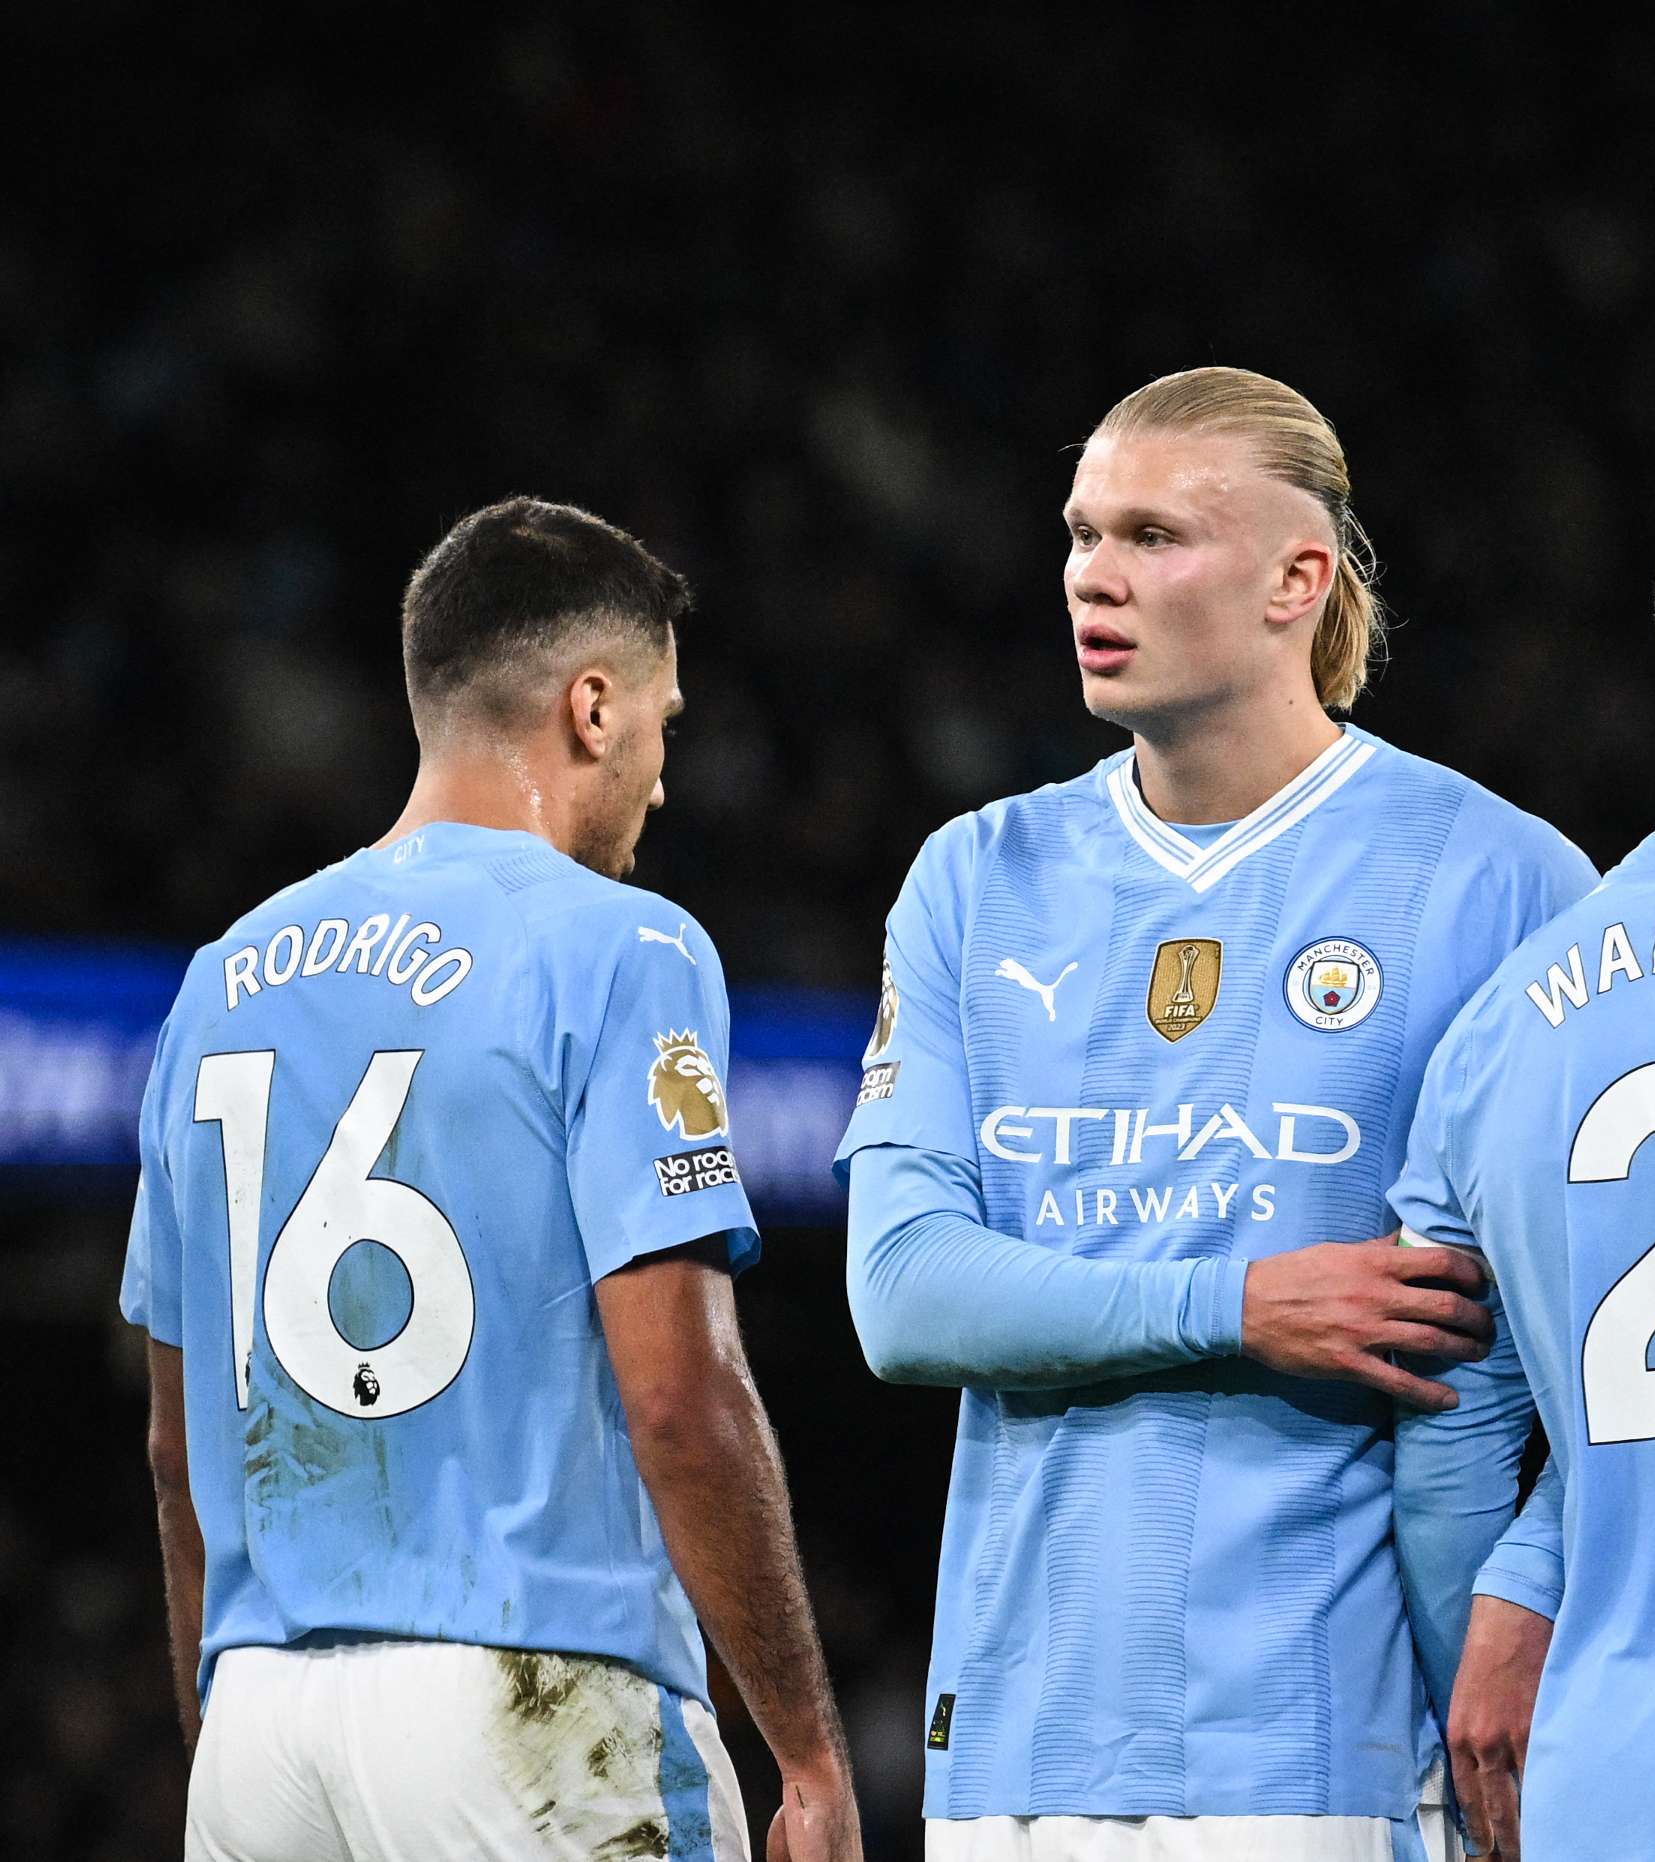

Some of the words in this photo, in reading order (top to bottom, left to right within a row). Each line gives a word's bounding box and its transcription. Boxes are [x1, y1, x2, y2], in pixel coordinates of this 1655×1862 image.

[222, 912, 474, 1012] RODRIGO
[1297, 944, 1375, 976] MANCHESTER
[1164, 1004, 1196, 1018] FIFA
[1315, 1016, 1344, 1026] CITY
[980, 1102, 1361, 1165] ETIHAD
[653, 1157, 690, 1177] No
[660, 1175, 692, 1196] for
[1035, 1182, 1276, 1226] AIRWAYS
[193, 1049, 475, 1420] 16
